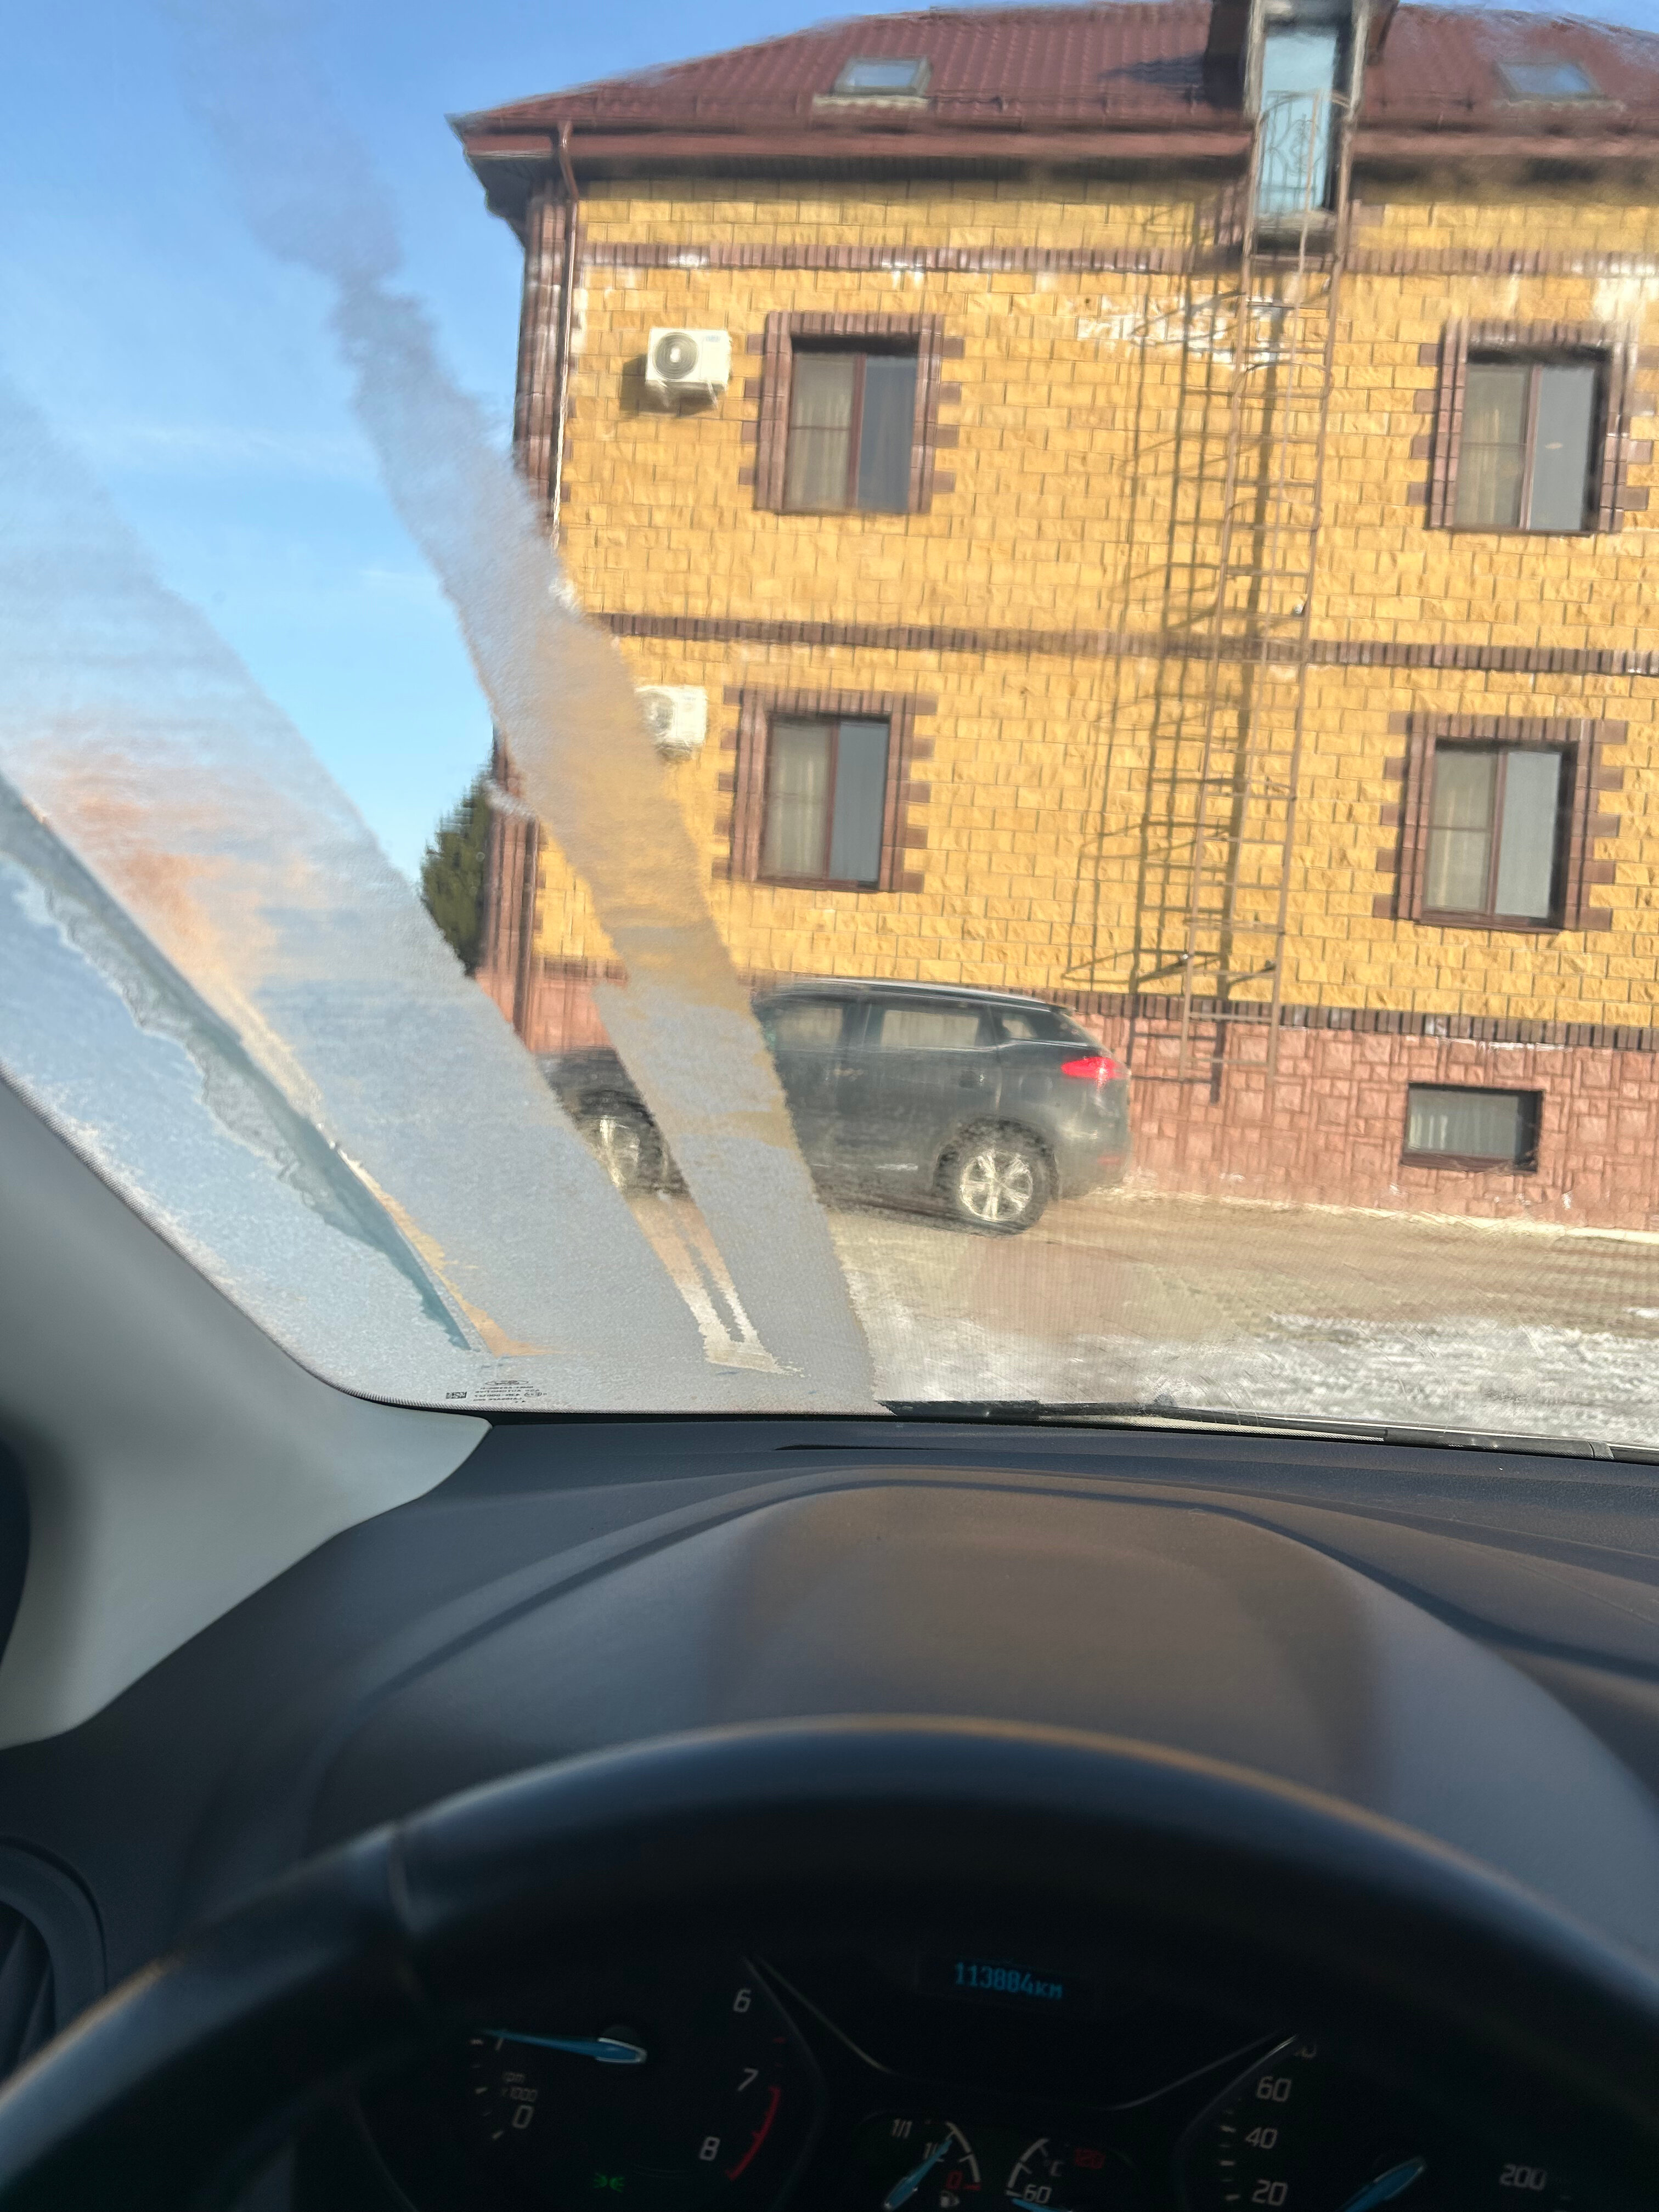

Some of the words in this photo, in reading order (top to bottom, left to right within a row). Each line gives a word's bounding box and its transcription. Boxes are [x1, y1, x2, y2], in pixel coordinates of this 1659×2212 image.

[732, 1988, 752, 2013] 6
[737, 2067, 759, 2092] 7
[1255, 2075, 1293, 2102] 60
[511, 2104, 536, 2129] 0
[698, 2136, 721, 2161] 8
[1244, 2126, 1278, 2149] 40
[945, 2170, 964, 2191] 0
[1499, 2163, 1548, 2192] 200
[1023, 2183, 1053, 2204] 60
[1251, 2178, 1289, 2207] 20
